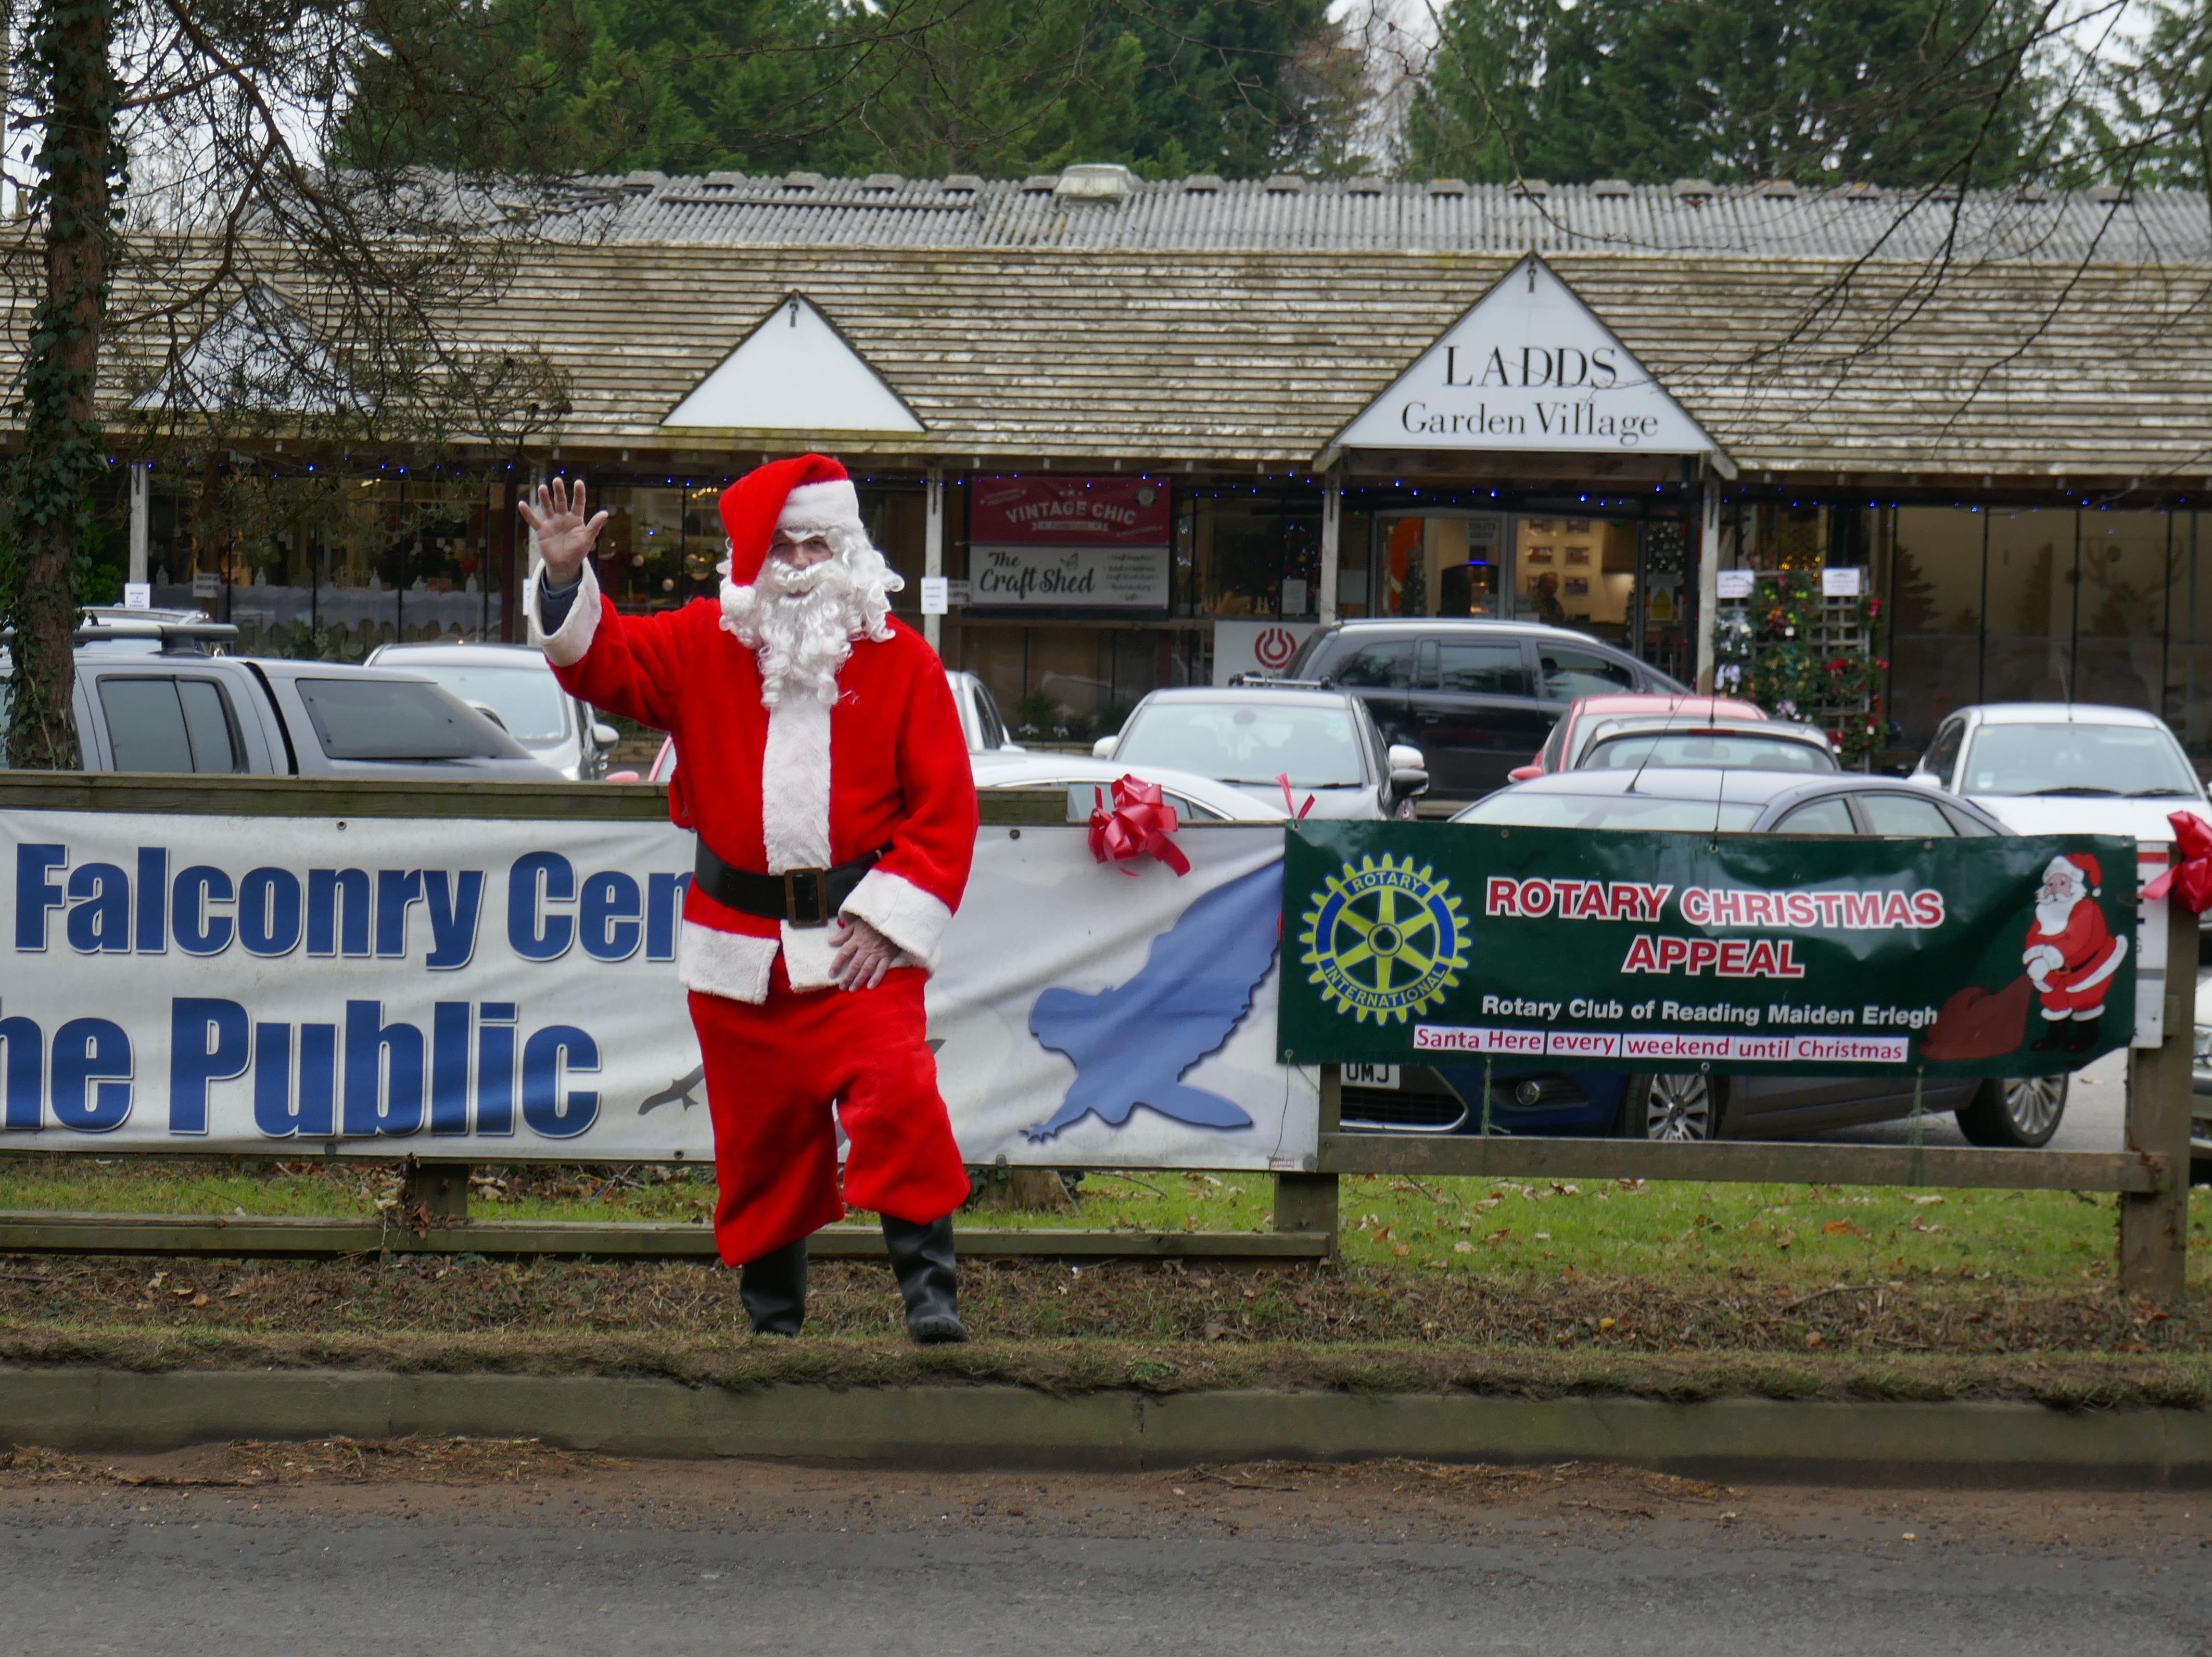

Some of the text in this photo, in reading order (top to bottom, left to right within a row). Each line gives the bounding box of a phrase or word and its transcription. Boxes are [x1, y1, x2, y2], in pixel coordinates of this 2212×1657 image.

[1442, 346, 1617, 388] LADDS
[1402, 402, 1659, 445] Garden Village
[1006, 501, 1136, 525] VINTAGE CHIC
[988, 552, 1021, 567] The
[980, 567, 1037, 600] Craft
[1040, 567, 1095, 593] Shed
[1351, 871, 1423, 893] ROTARY
[16, 843, 485, 970] Falconry
[1486, 877, 1943, 929] ROTARY CHRISTMAS
[1621, 935, 1806, 978] APPEAL
[1325, 967, 1446, 1008] INTERNATIONAL
[1482, 996, 1938, 1030] Rotary Club of Reading Maiden Erlegh
[1418, 1027, 1903, 1060] Santa Here every weekend until Christmas
[170, 997, 602, 1138] Public
